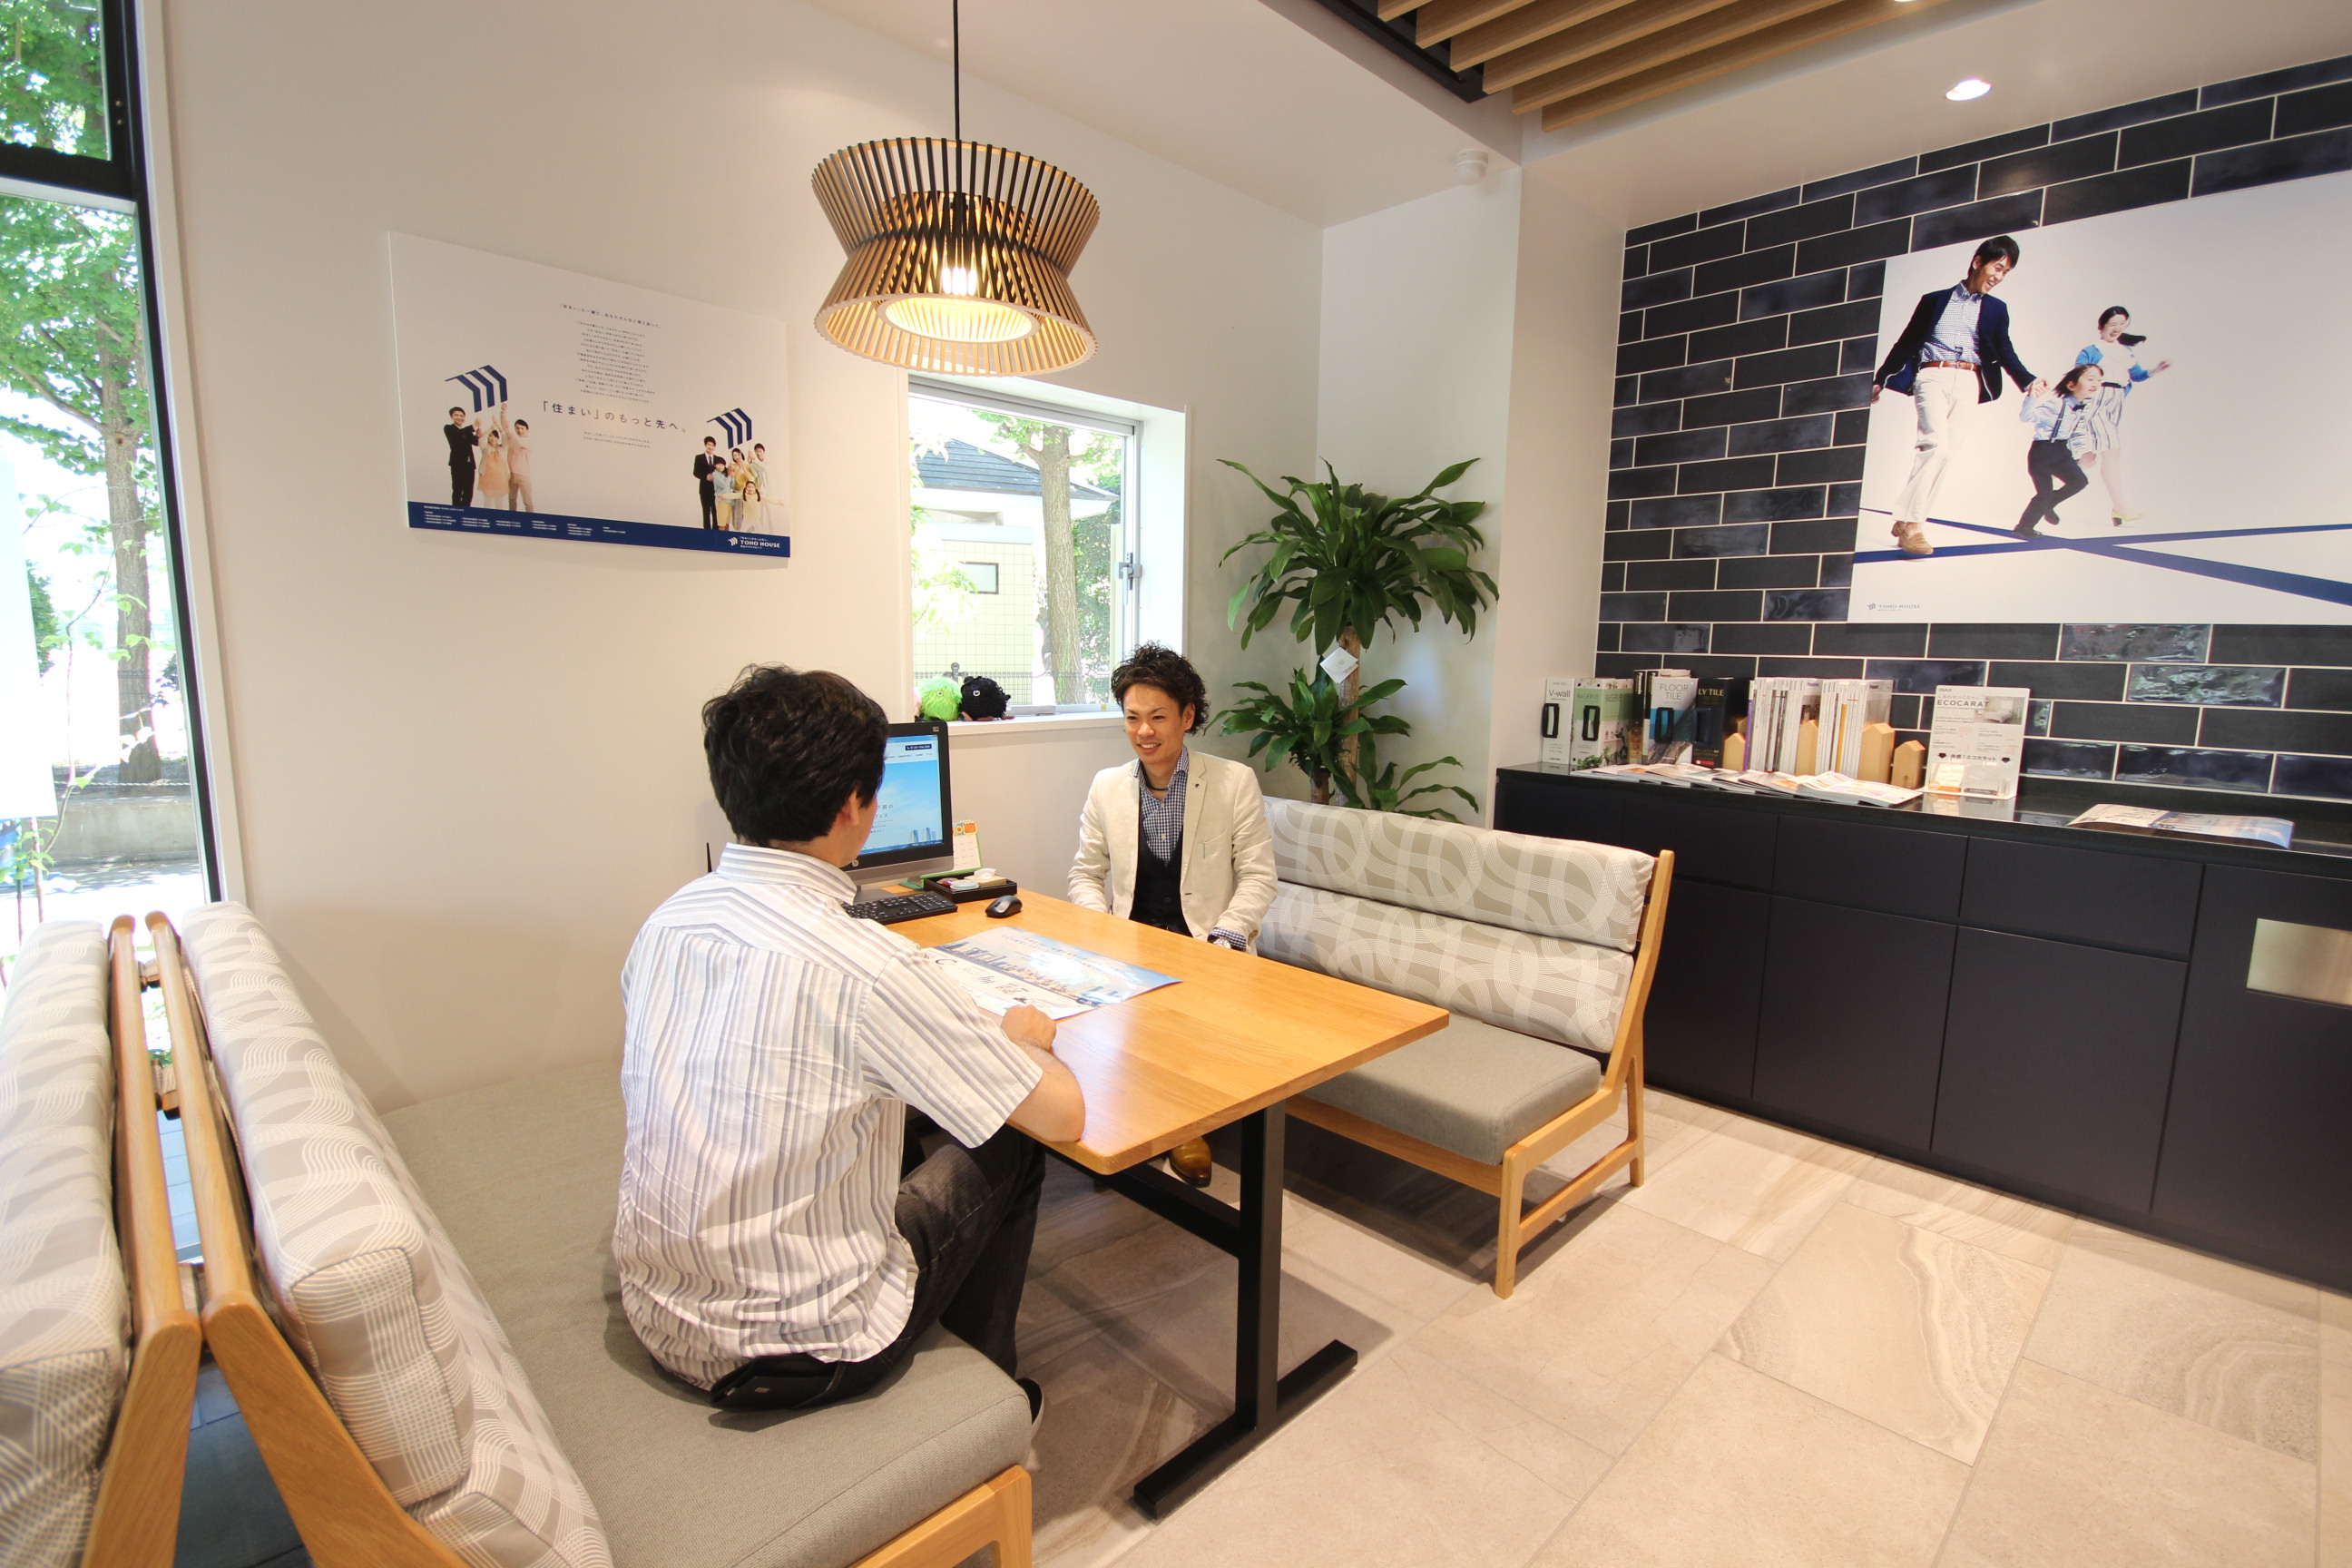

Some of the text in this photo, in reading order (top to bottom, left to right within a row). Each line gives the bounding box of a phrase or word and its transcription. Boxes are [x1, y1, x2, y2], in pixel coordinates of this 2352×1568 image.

[542, 400, 687, 433] 「住まい」のもっと先へ。
[740, 539, 781, 549] TOHO HOUSE
[1660, 683, 1689, 692] FLOOR
[1548, 689, 1571, 698] V-wall
[1665, 691, 1681, 701] TILE
[1709, 688, 1724, 697] TILE
[1936, 699, 1989, 708] ECOCARAT
